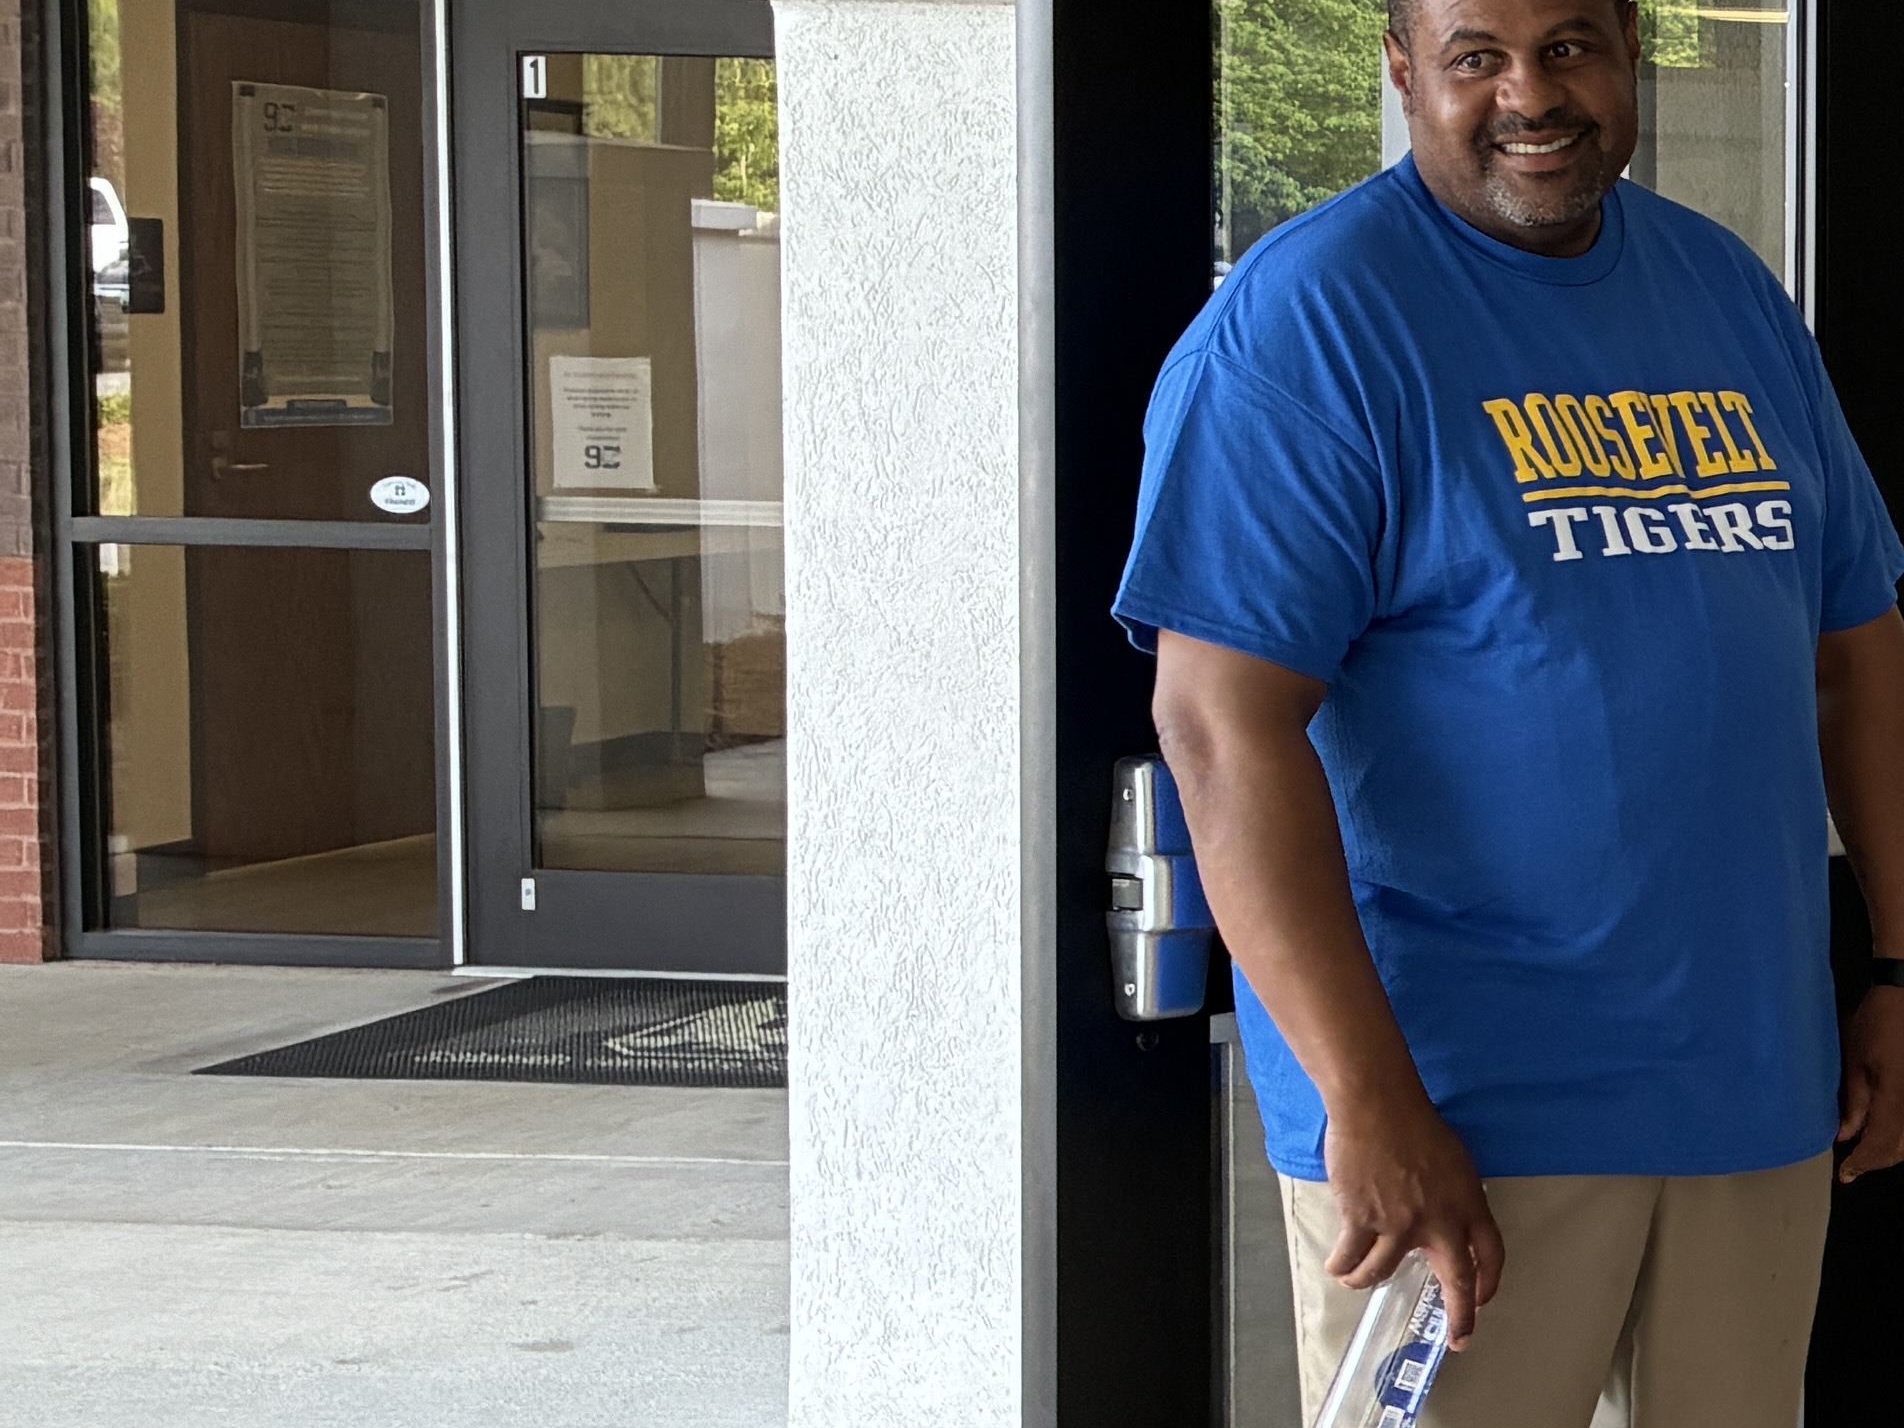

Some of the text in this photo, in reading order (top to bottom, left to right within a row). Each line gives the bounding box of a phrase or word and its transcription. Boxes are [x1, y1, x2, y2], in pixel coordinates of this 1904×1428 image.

[529, 58, 539, 95] 1
[1482, 390, 1777, 483] ROOSEVELT
[1527, 500, 1795, 562] TIGERS
